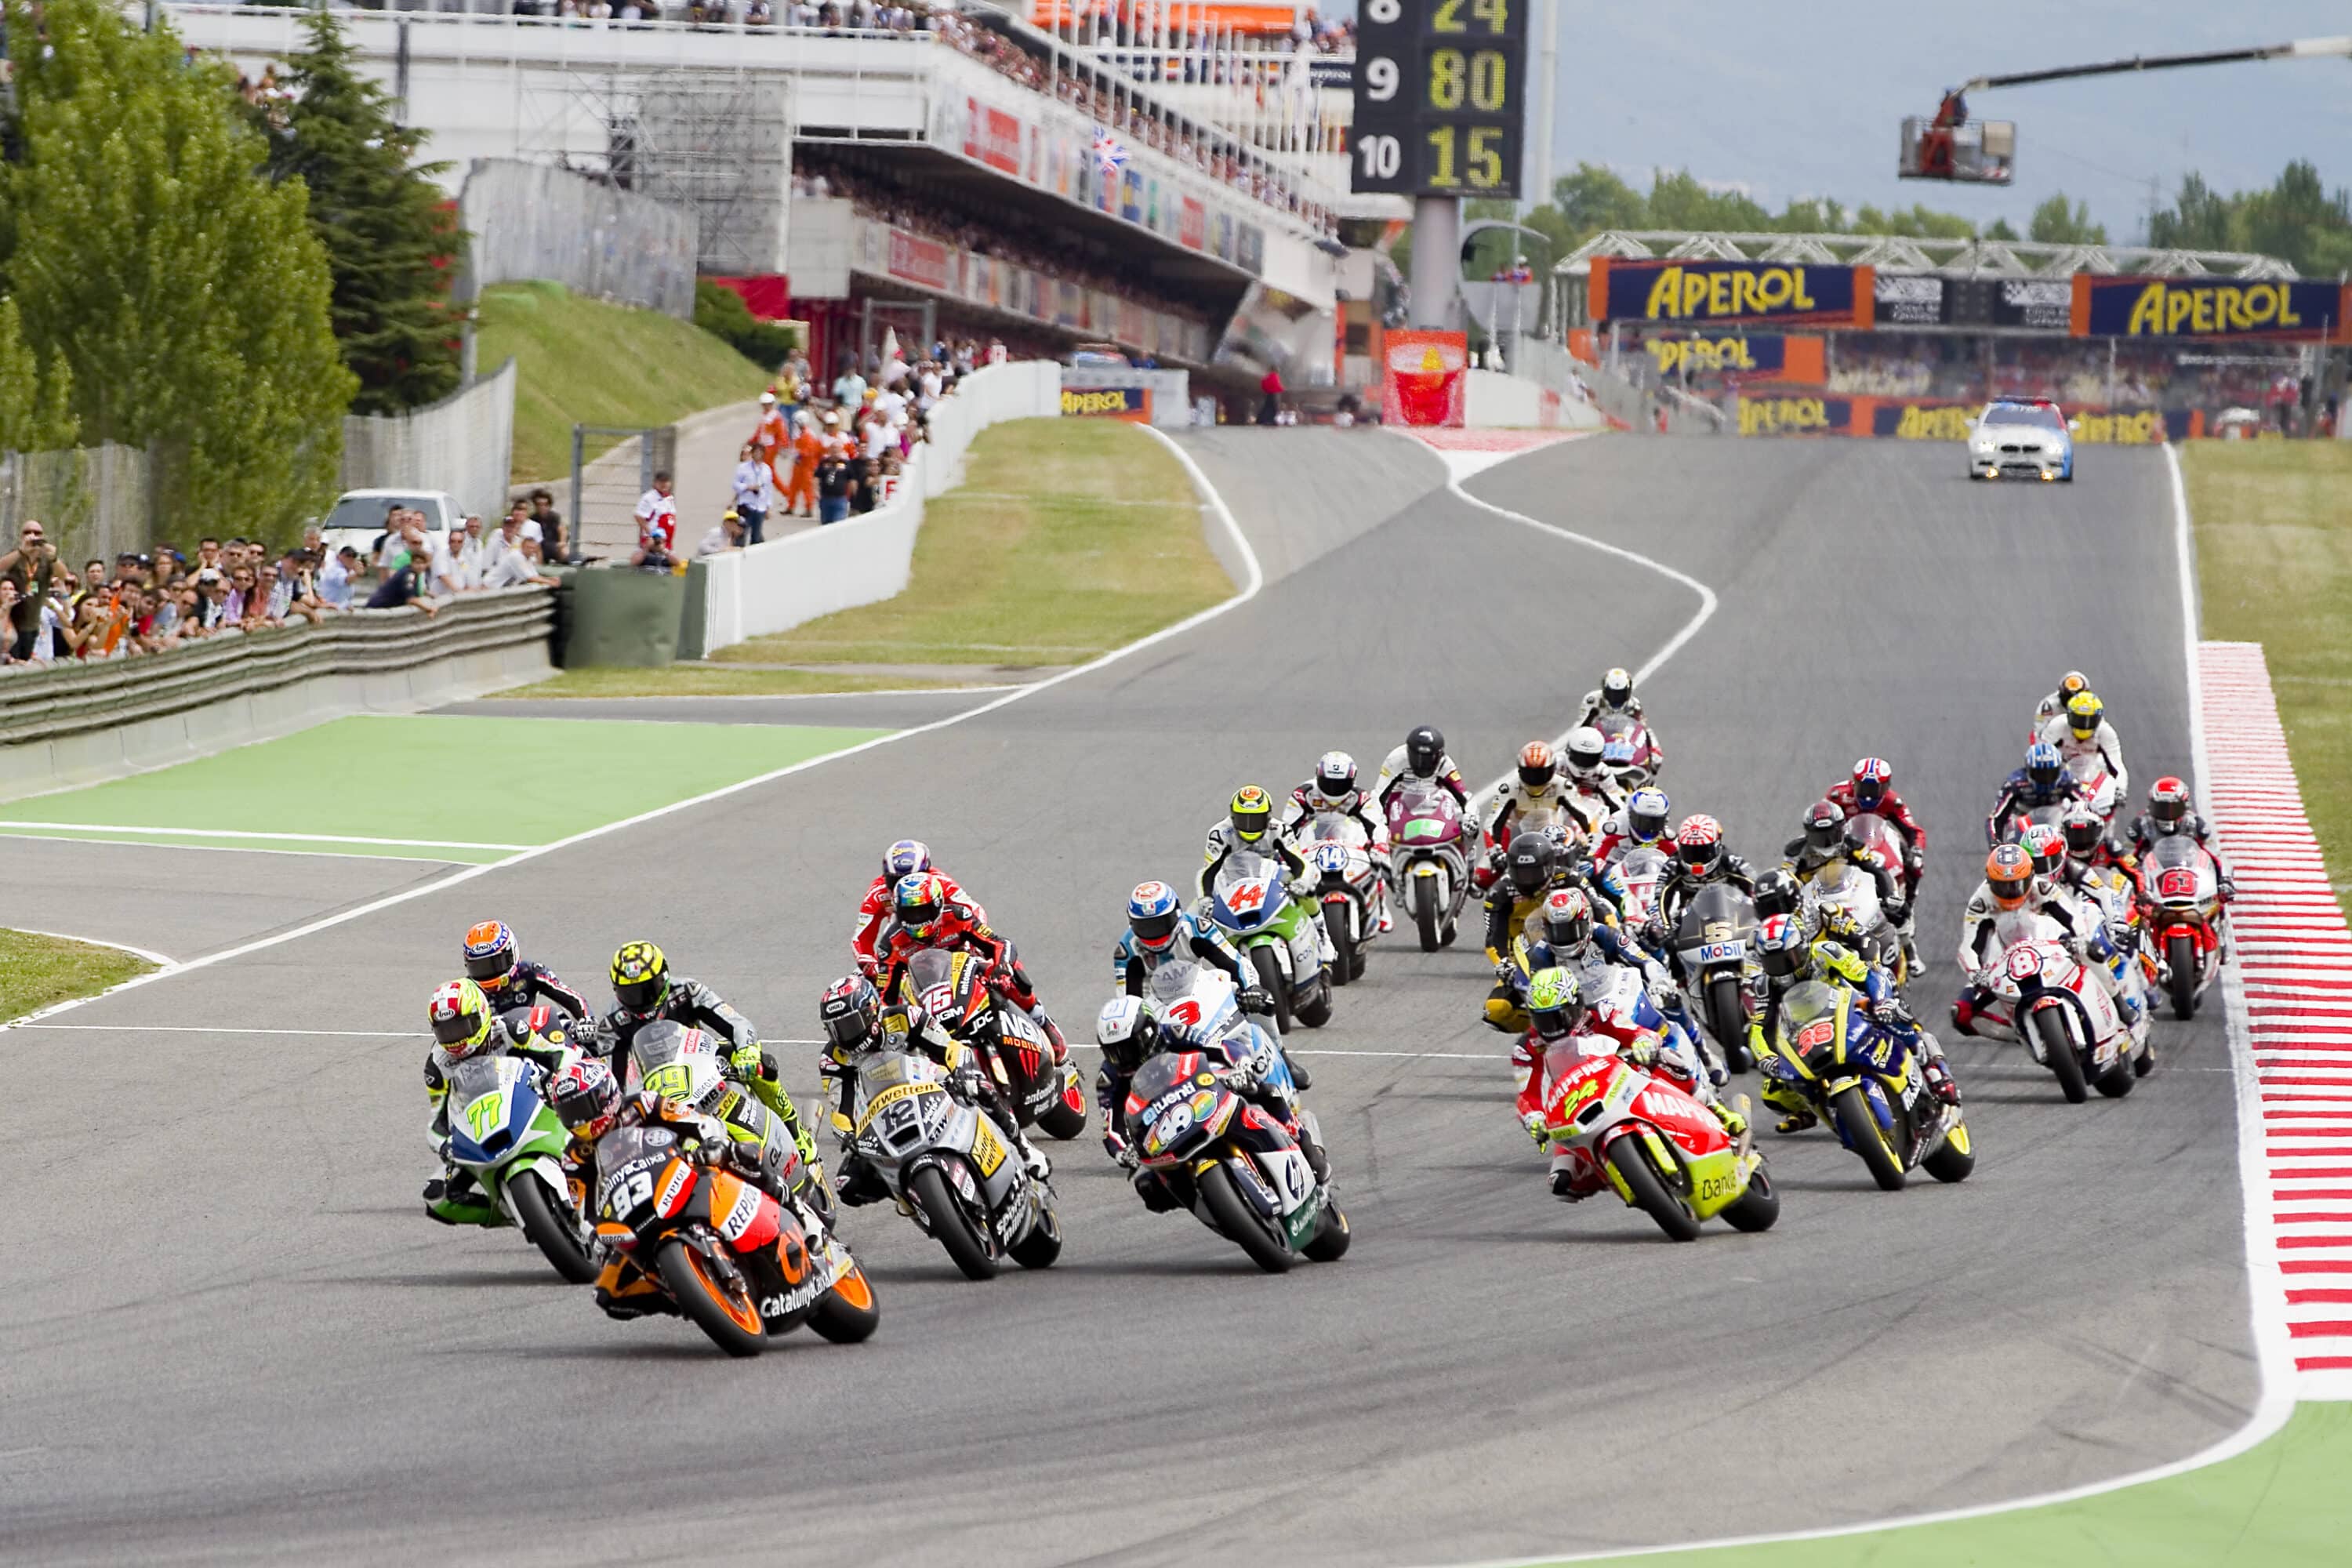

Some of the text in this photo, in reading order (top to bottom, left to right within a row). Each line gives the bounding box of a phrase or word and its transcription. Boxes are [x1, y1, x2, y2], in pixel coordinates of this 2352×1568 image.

[1367, 49, 1506, 111] 9 80
[1358, 125, 1503, 187] 10 15
[1648, 267, 1814, 318] APEROL
[2129, 281, 2299, 334] APEROL
[1319, 844, 1346, 869] 14
[1228, 884, 1265, 912] 44
[2161, 871, 2196, 895] 63
[1701, 944, 1742, 961] Mobil
[2011, 949, 2037, 979] 8
[923, 986, 953, 1014] 15
[1169, 1000, 1201, 1026] 3
[970, 1011, 994, 1036] JDC
[1797, 1022, 1835, 1058] 38
[1152, 1082, 1196, 1115] tuenti
[1548, 1058, 1610, 1113] MAPFRE
[1563, 1079, 1599, 1120] 24
[466, 1093, 503, 1142] 77
[880, 1098, 917, 1136] 12
[612, 1171, 653, 1221] 93
